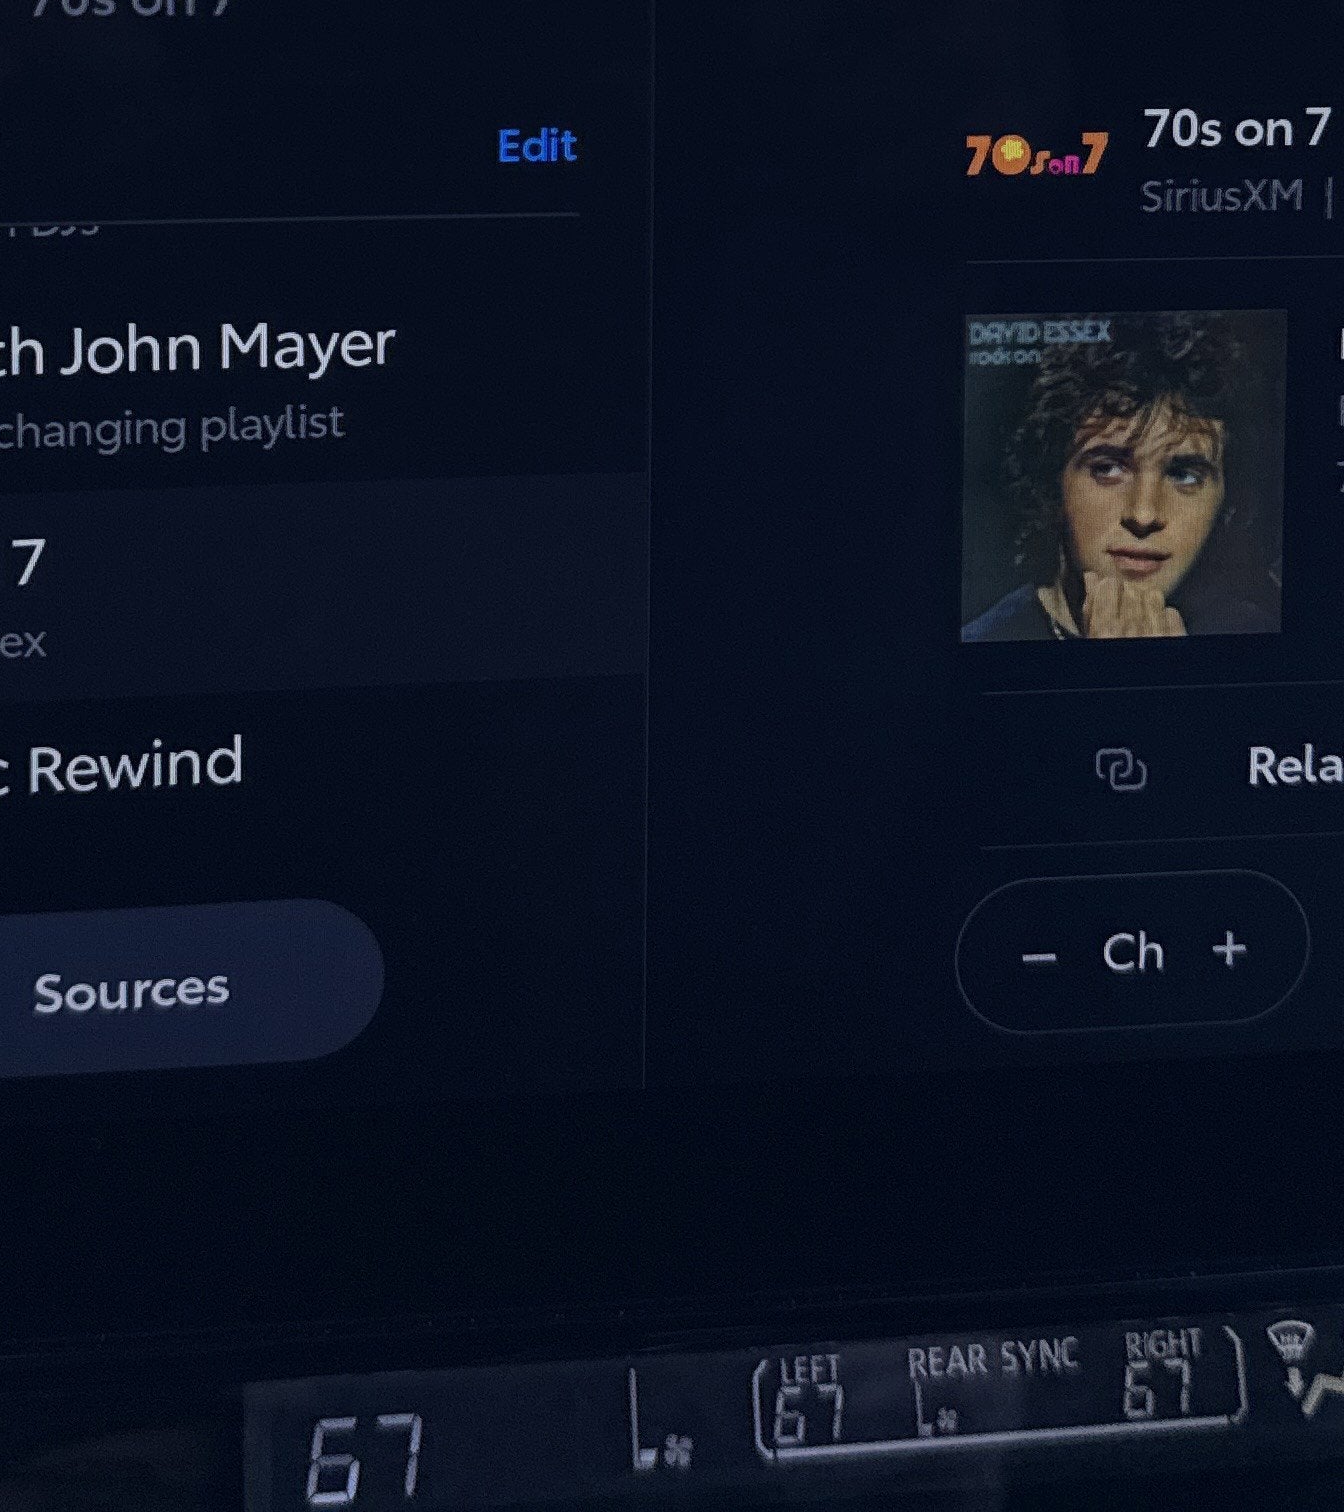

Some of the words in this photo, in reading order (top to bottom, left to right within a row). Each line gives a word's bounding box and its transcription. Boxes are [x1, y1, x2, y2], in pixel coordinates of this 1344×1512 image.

[498, 127, 578, 164] Edit
[1143, 108, 1222, 149] 70s
[1234, 117, 1293, 147] on
[1305, 107, 1331, 147] 7
[1141, 178, 1304, 214] SiriusXM
[60, 324, 201, 376] John
[221, 322, 396, 380] Mayer
[199, 405, 346, 450] playlist
[11, 538, 47, 587] 7
[29, 734, 244, 797] Rewind
[1103, 932, 1164, 972] Ch
[34, 970, 230, 1015] Sources
[909, 1344, 987, 1379] REAR
[1001, 1336, 1078, 1373] SYNC
[1125, 1327, 1201, 1358] RIGHT
[780, 1354, 840, 1385] LEFT
[1123, 1359, 1191, 1420] 67
[774, 1385, 844, 1445] 67
[307, 1413, 422, 1506] 67
